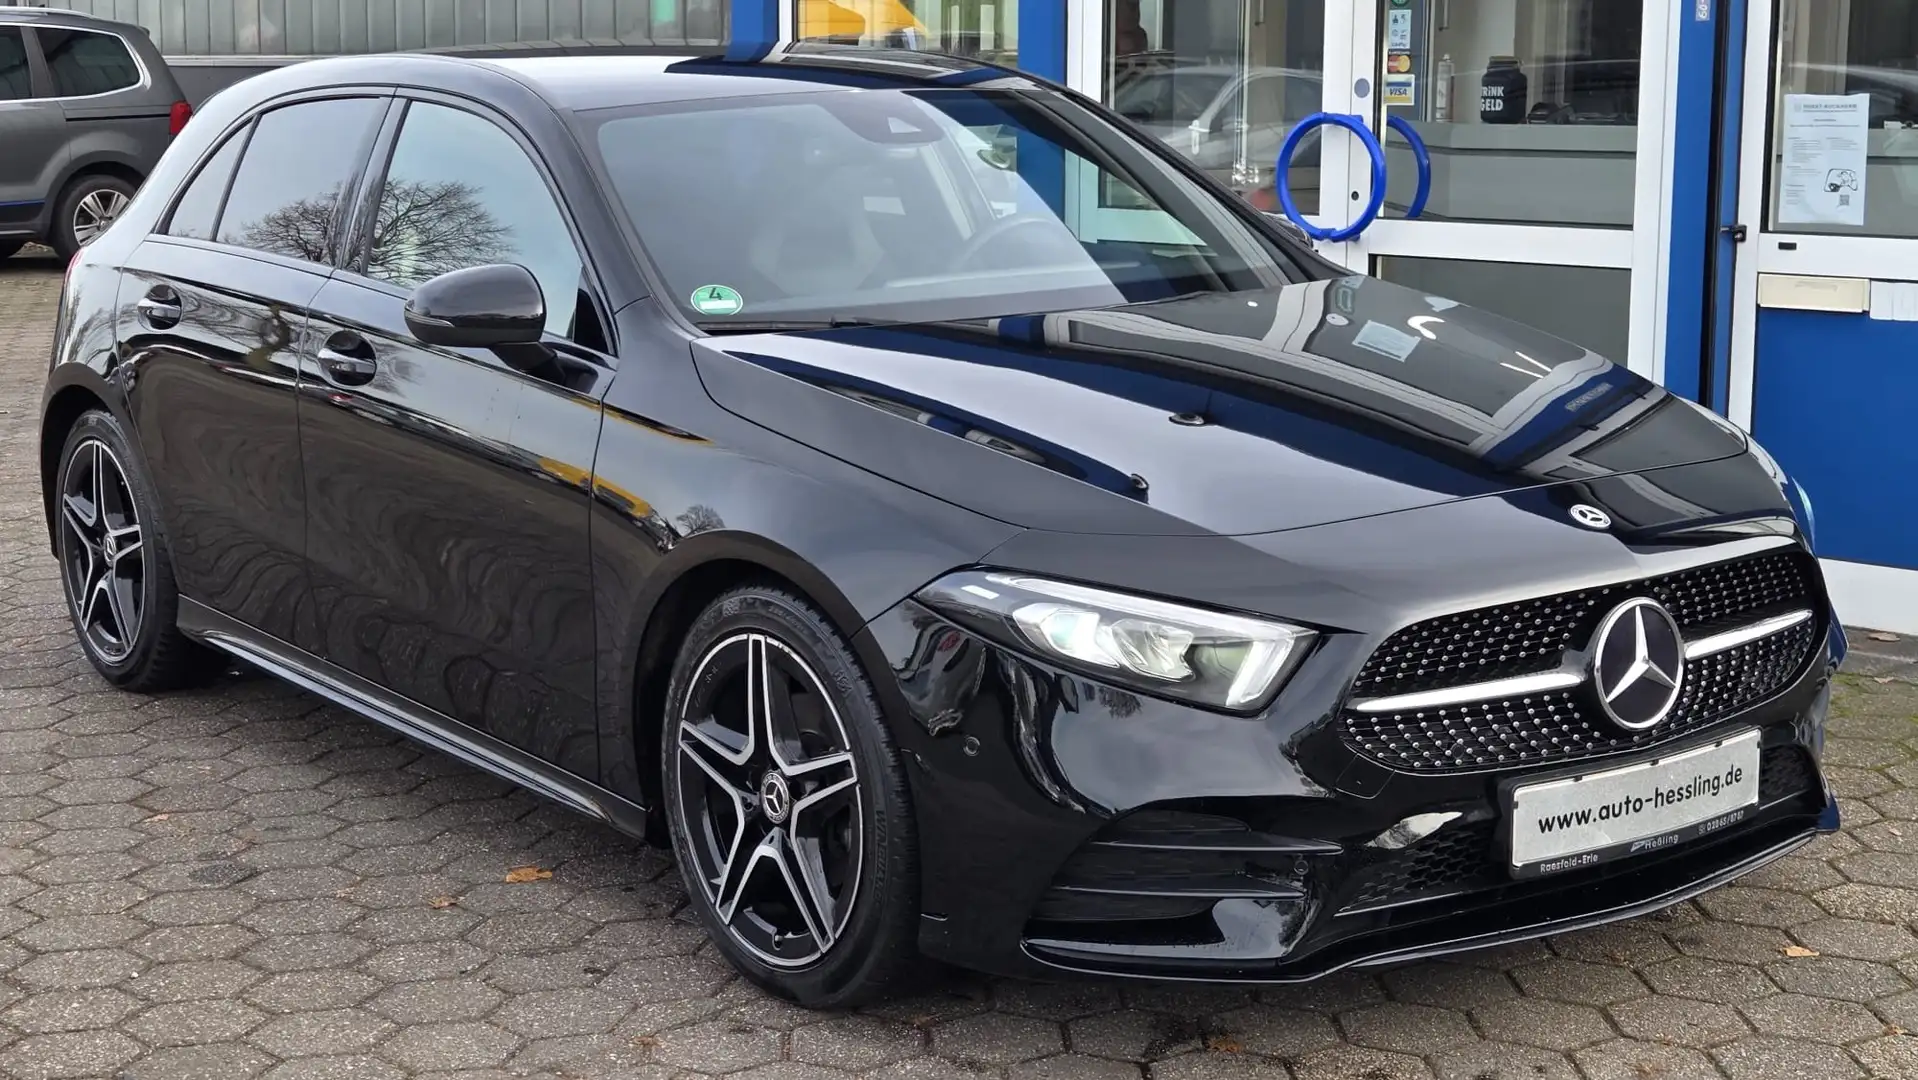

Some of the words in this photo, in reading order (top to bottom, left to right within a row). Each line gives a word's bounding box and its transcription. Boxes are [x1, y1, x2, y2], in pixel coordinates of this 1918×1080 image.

[1389, 88, 1407, 96] VISA
[709, 287, 722, 300] 4
[1538, 764, 1743, 834] www.auto-hessling.de
